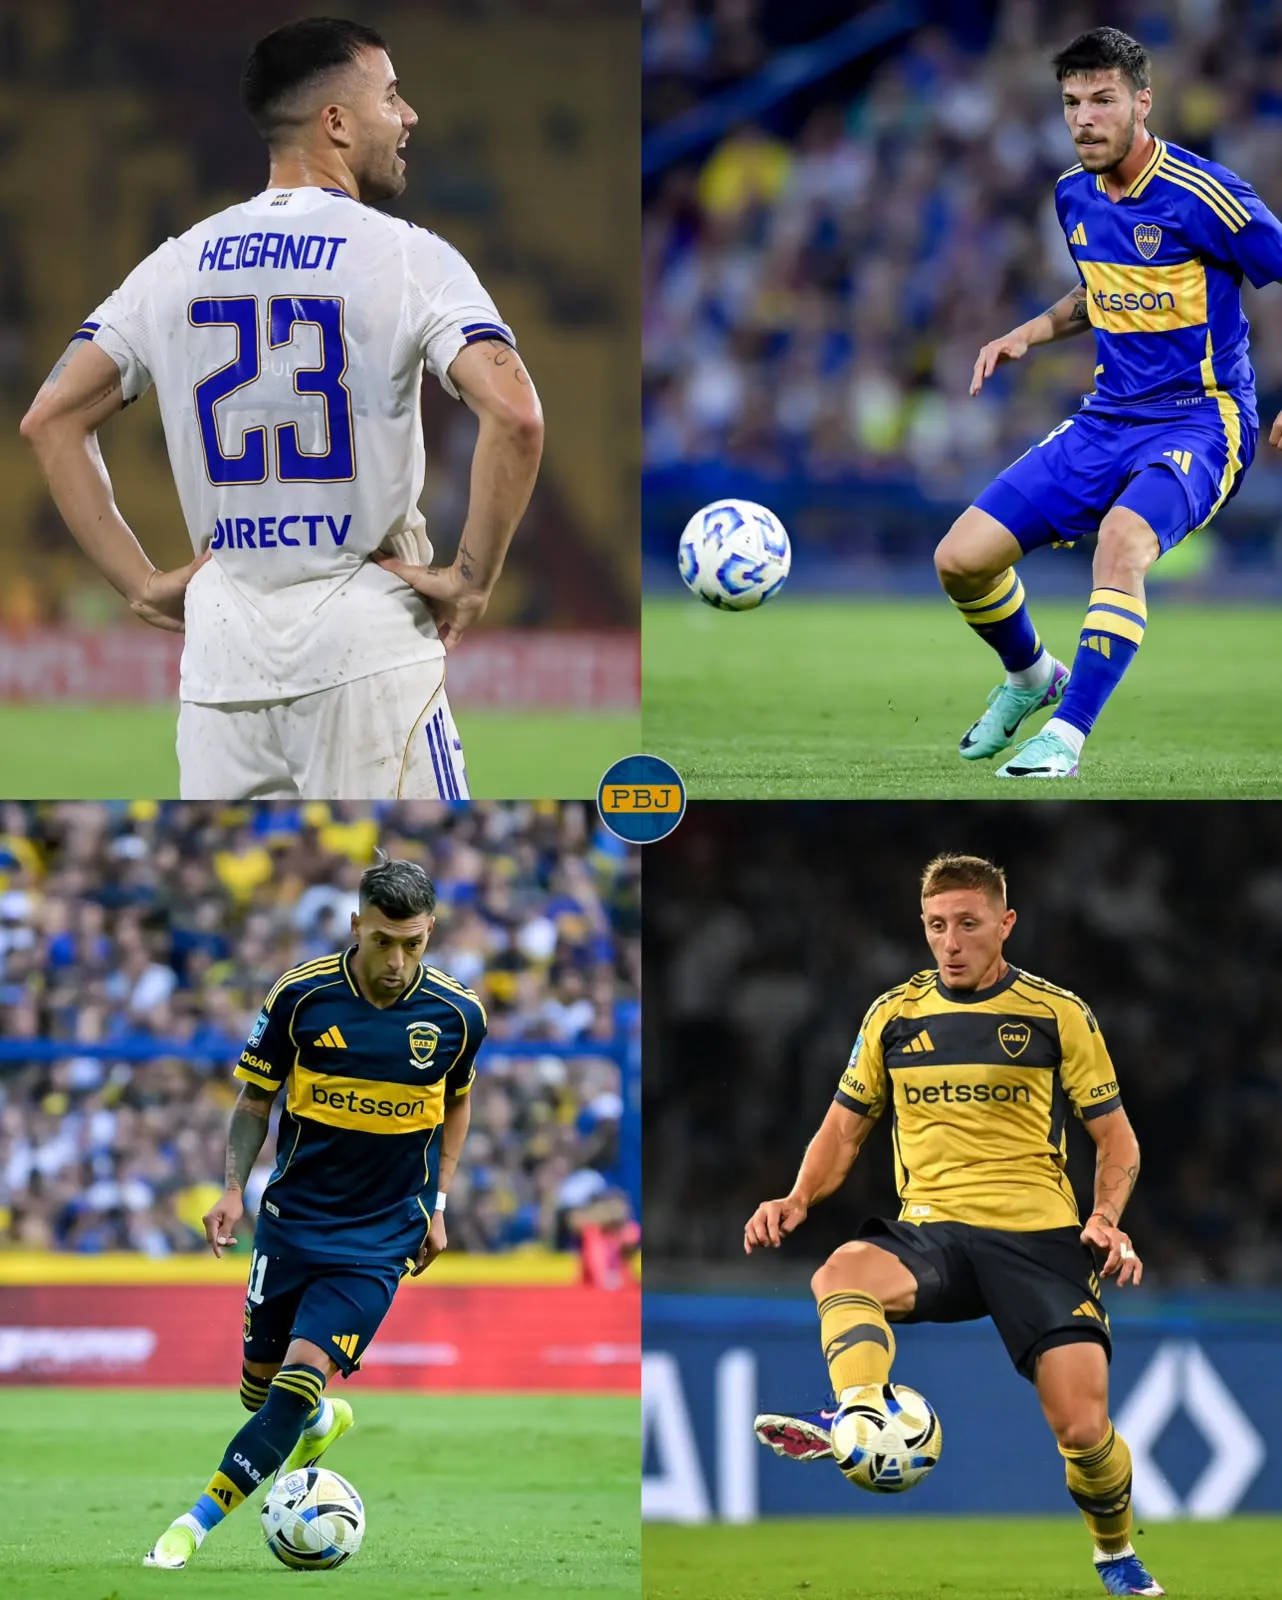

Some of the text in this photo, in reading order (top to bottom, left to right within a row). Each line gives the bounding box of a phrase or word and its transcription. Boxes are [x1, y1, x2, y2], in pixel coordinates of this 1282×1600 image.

[199, 232, 347, 271] WEIGANDT
[1137, 235, 1158, 244] CABJ
[188, 294, 357, 487] 23
[413, 1040, 433, 1048] CABJ
[1002, 1033, 1027, 1042] CABJ
[312, 1084, 425, 1117] betsson
[903, 1080, 1031, 1104] betsson
